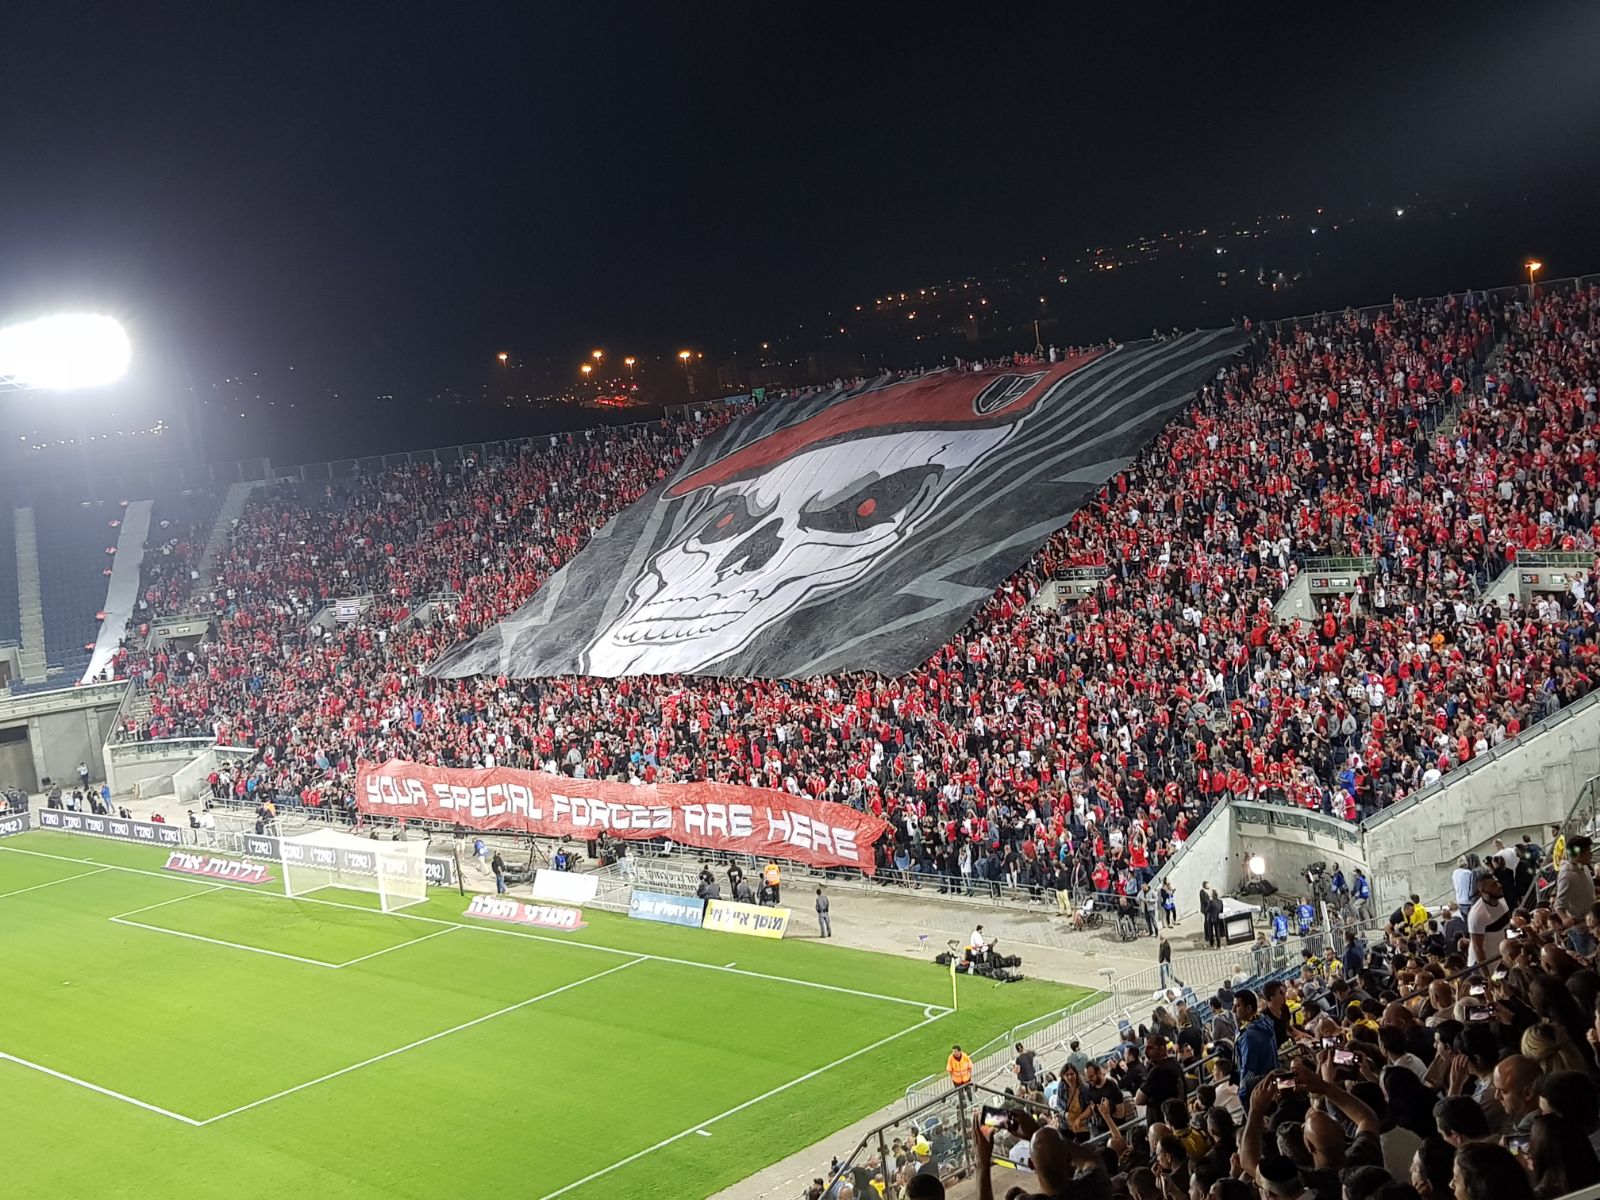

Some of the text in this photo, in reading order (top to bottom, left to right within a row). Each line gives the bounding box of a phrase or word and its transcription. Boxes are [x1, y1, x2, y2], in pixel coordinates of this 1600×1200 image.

[366, 775, 859, 861] YOUR SPECIAL FORCES ARE HERE
[752, 913, 784, 930] מוסך
